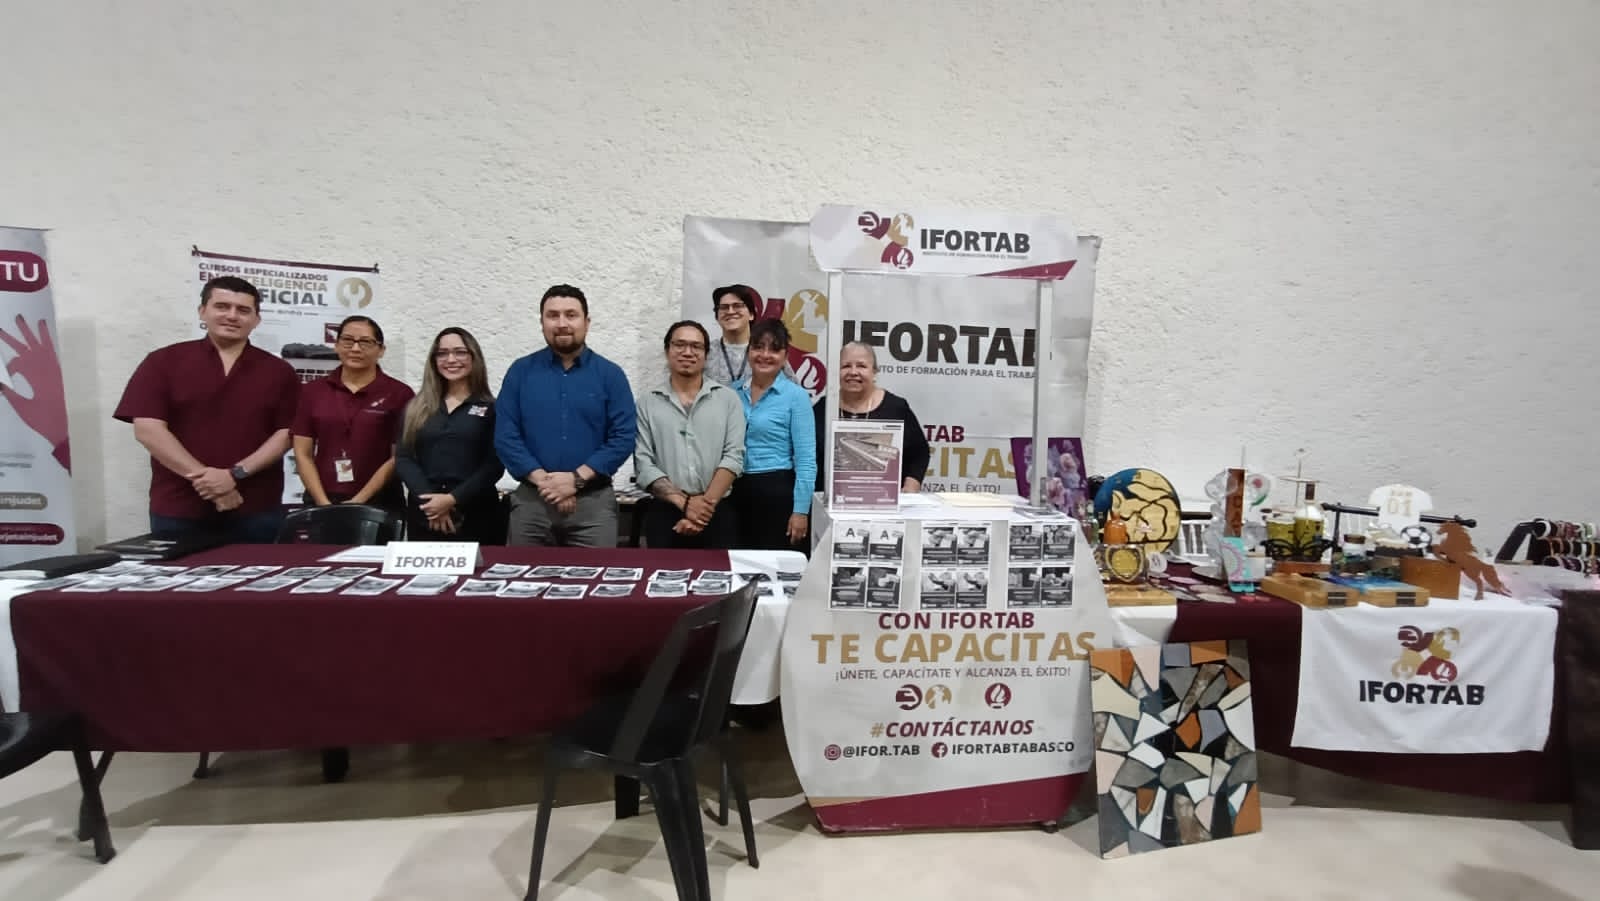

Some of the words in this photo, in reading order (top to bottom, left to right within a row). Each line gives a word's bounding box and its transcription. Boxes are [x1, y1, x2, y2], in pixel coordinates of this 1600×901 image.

[920, 228, 1031, 254] IFORTAB
[199, 263, 240, 274] CURSOS
[244, 267, 329, 281] ESPECIALIZADOS
[259, 288, 328, 306] FICIAL
[896, 366, 909, 374] DE
[911, 365, 968, 377] FORMACIÓN
[970, 369, 993, 378] PARA
[996, 369, 1006, 378] EL
[950, 483, 960, 493] EL
[966, 482, 1001, 494] ÉXITO!
[394, 556, 467, 568] IFORTAB
[878, 612, 931, 630] CON
[940, 611, 1035, 630] IFORTAB
[811, 633, 860, 664] TE
[874, 631, 1096, 663] CAPACITAS
[883, 668, 950, 679] CAPACÍTATE
[954, 668, 961, 678] Y
[966, 668, 1017, 678] ALCANZA
[1021, 668, 1032, 677] EL
[1036, 665, 1071, 677] ÉXITO!
[1359, 680, 1485, 706] IFORTAB
[870, 717, 1035, 738] #CONTÁCTANOS
[843, 744, 920, 758] @IFOR.TAB
[952, 741, 1075, 755] IFORTABTABASCO
